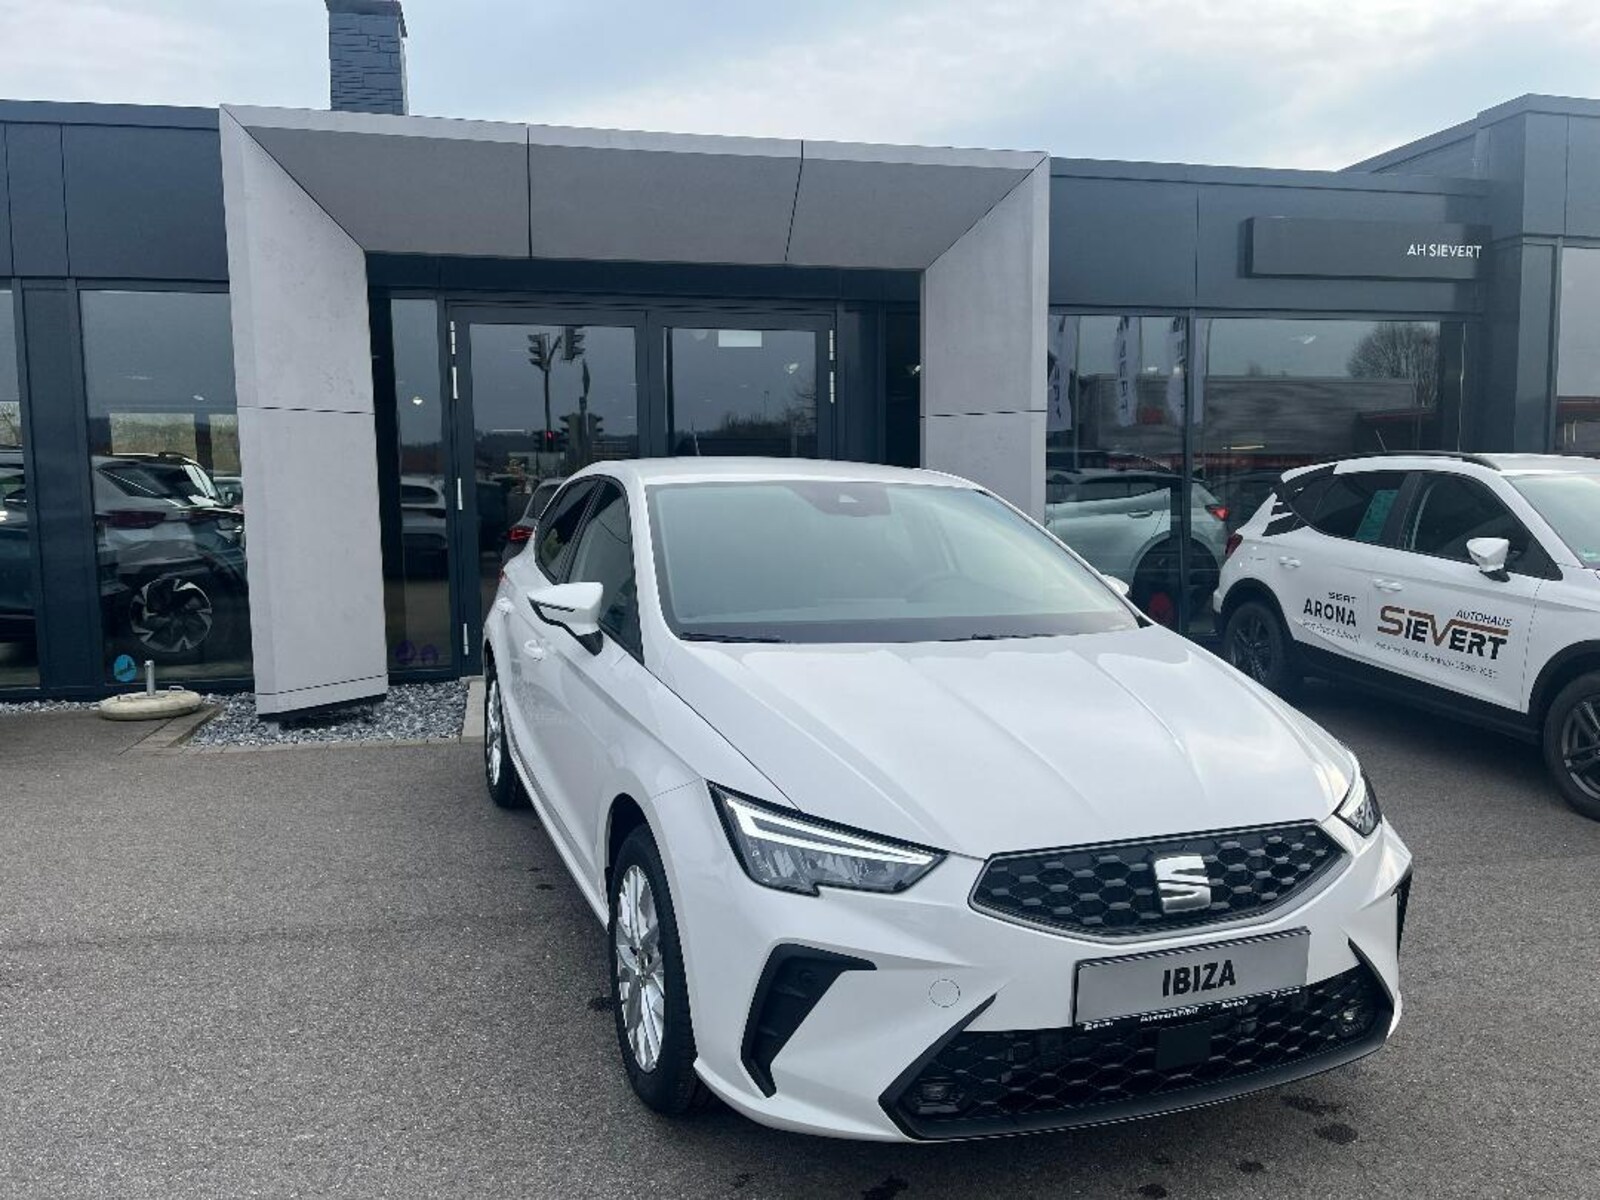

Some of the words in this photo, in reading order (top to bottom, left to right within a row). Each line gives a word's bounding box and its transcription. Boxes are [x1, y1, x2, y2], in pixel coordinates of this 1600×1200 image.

[1407, 243, 1426, 257] AH
[1429, 243, 1482, 259] SIEVERT
[1328, 591, 1357, 604] SEAT
[1303, 598, 1357, 628] ARONA
[1455, 609, 1513, 628] AUTOHAUS
[1377, 605, 1509, 660] SIEVERT
[1162, 959, 1236, 997] IBIZA
